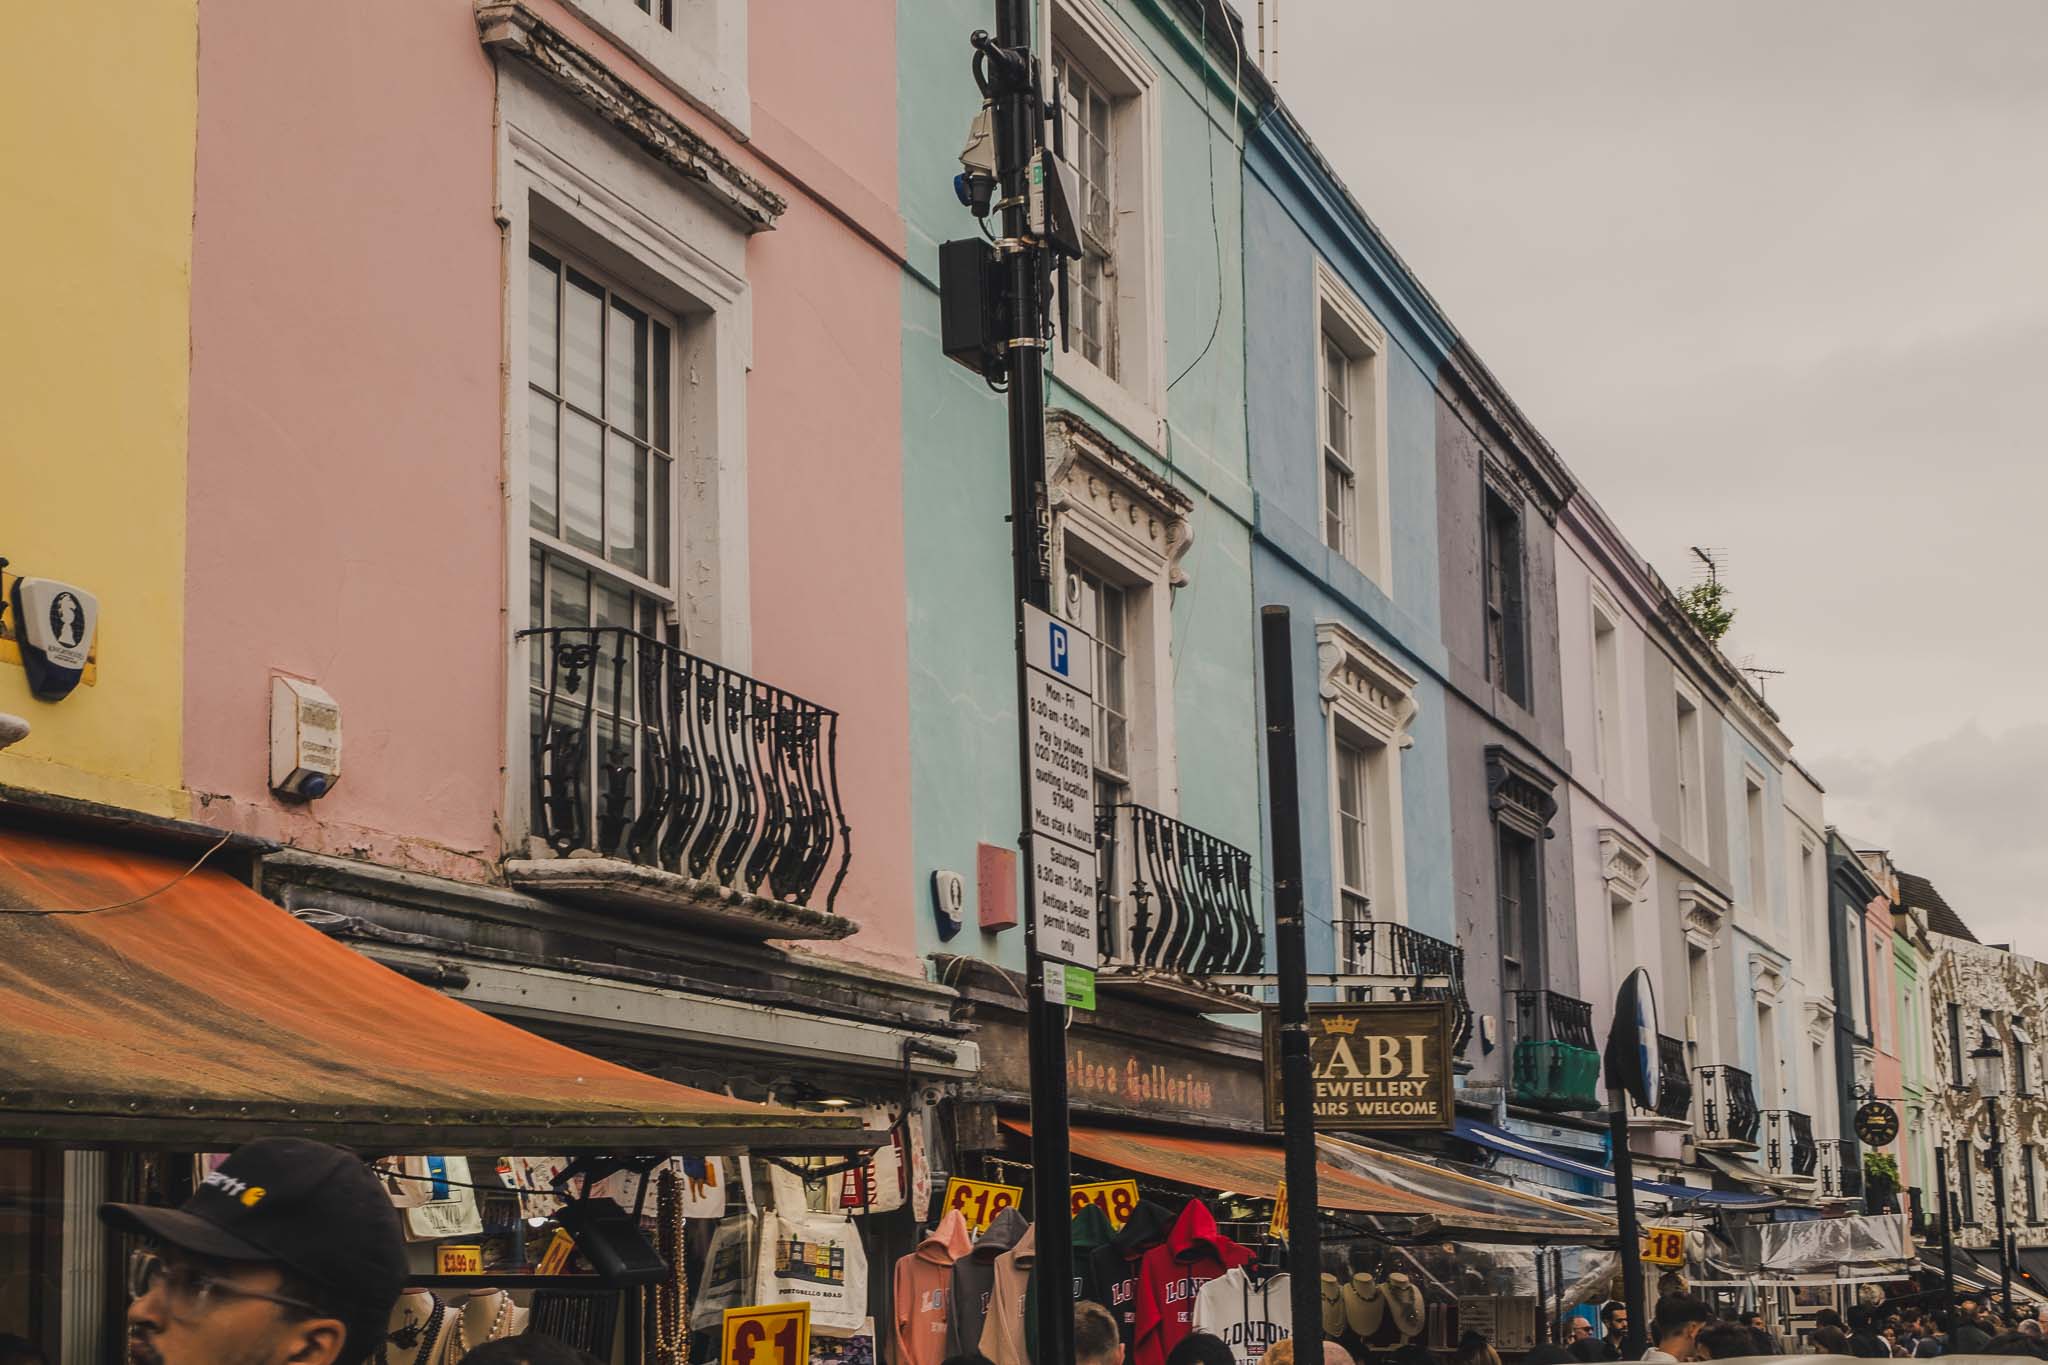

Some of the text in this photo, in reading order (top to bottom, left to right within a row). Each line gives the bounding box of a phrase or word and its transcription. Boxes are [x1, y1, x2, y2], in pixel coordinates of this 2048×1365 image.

[1031, 697, 1047, 718] 8.30
[1050, 710, 1059, 723] am
[1035, 742, 1050, 761] 020
[1040, 725, 1083, 759] Pay by phone
[1036, 768, 1089, 800] quoting location
[1036, 808, 1050, 827] Max
[1052, 817, 1065, 836] stay
[1074, 825, 1092, 845] hours
[1050, 847, 1080, 874] Saturday
[1055, 873, 1064, 887] am
[1042, 890, 1090, 920] Antique Dealer
[1043, 914, 1090, 940] permit holders
[1061, 938, 1075, 957] only
[1315, 1081, 1428, 1097] EWELLERY
[1309, 1101, 1437, 1116] AIRS WELCOME
[1641, 1233, 1681, 1260] 18
[778, 1288, 843, 1299] PORTOBELLO ROAD
[921, 1287, 950, 1312] LO
[1111, 1277, 1141, 1306] LO
[1223, 1320, 1290, 1346] LONDON
